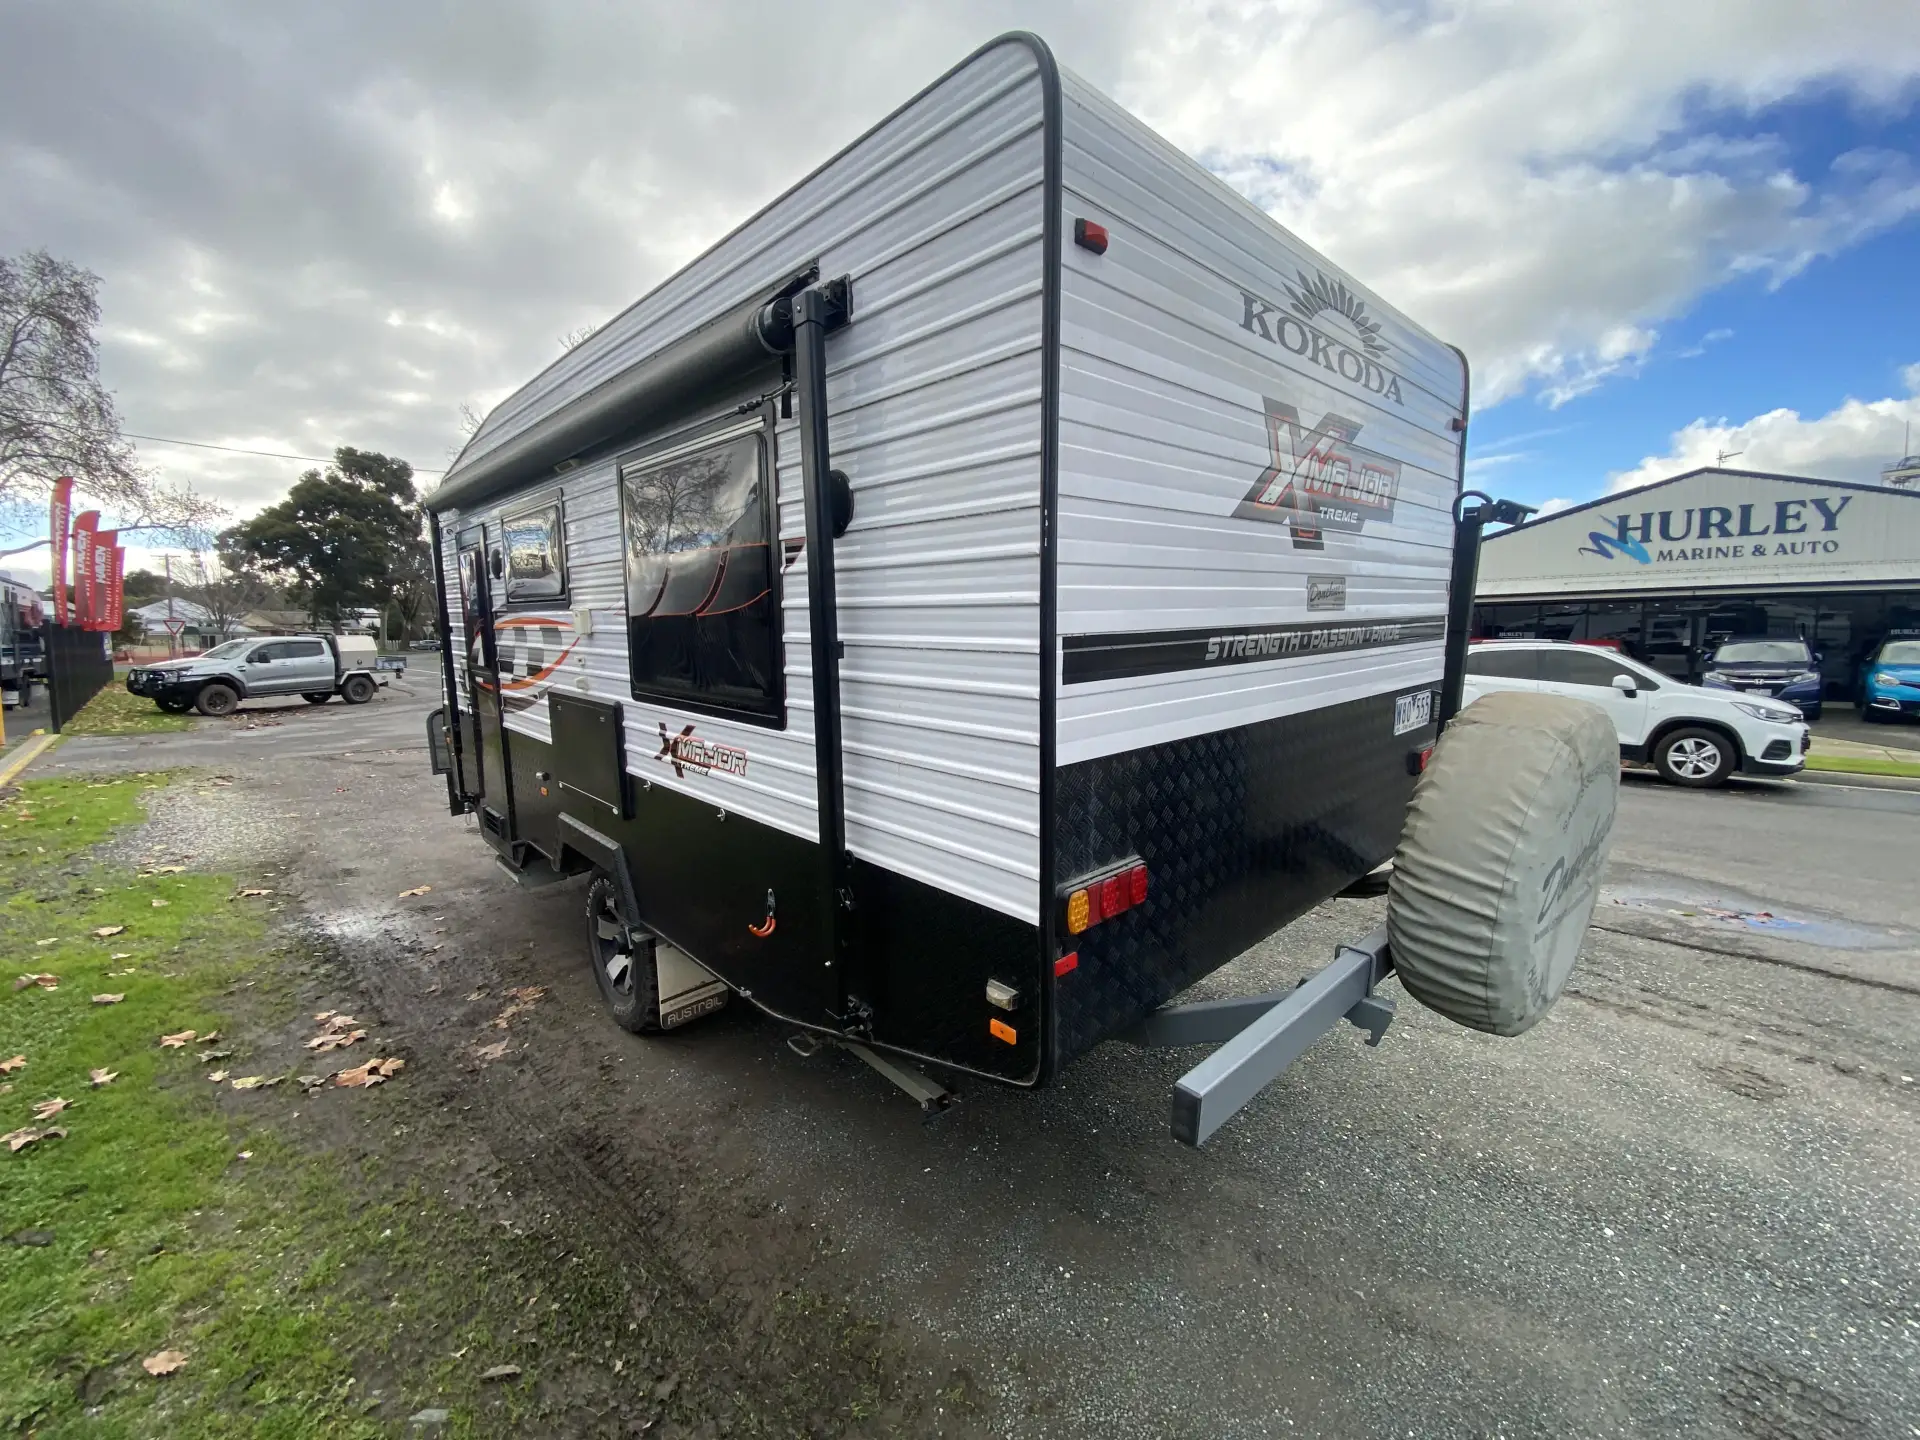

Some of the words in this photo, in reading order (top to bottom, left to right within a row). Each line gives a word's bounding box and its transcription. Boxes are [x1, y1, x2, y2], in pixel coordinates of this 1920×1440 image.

[1239, 291, 1404, 406] KOKODA
[1319, 506, 1359, 525] TREME
[1616, 495, 1853, 545] HURLEY
[1656, 544, 1745, 563] MARINE
[1751, 544, 1768, 558] &
[1773, 539, 1840, 556] AUTO
[1205, 631, 1301, 660] STRENGTH
[1309, 626, 1365, 650] PASSION
[1370, 624, 1401, 643] PRIDE
[679, 761, 710, 777] TREME
